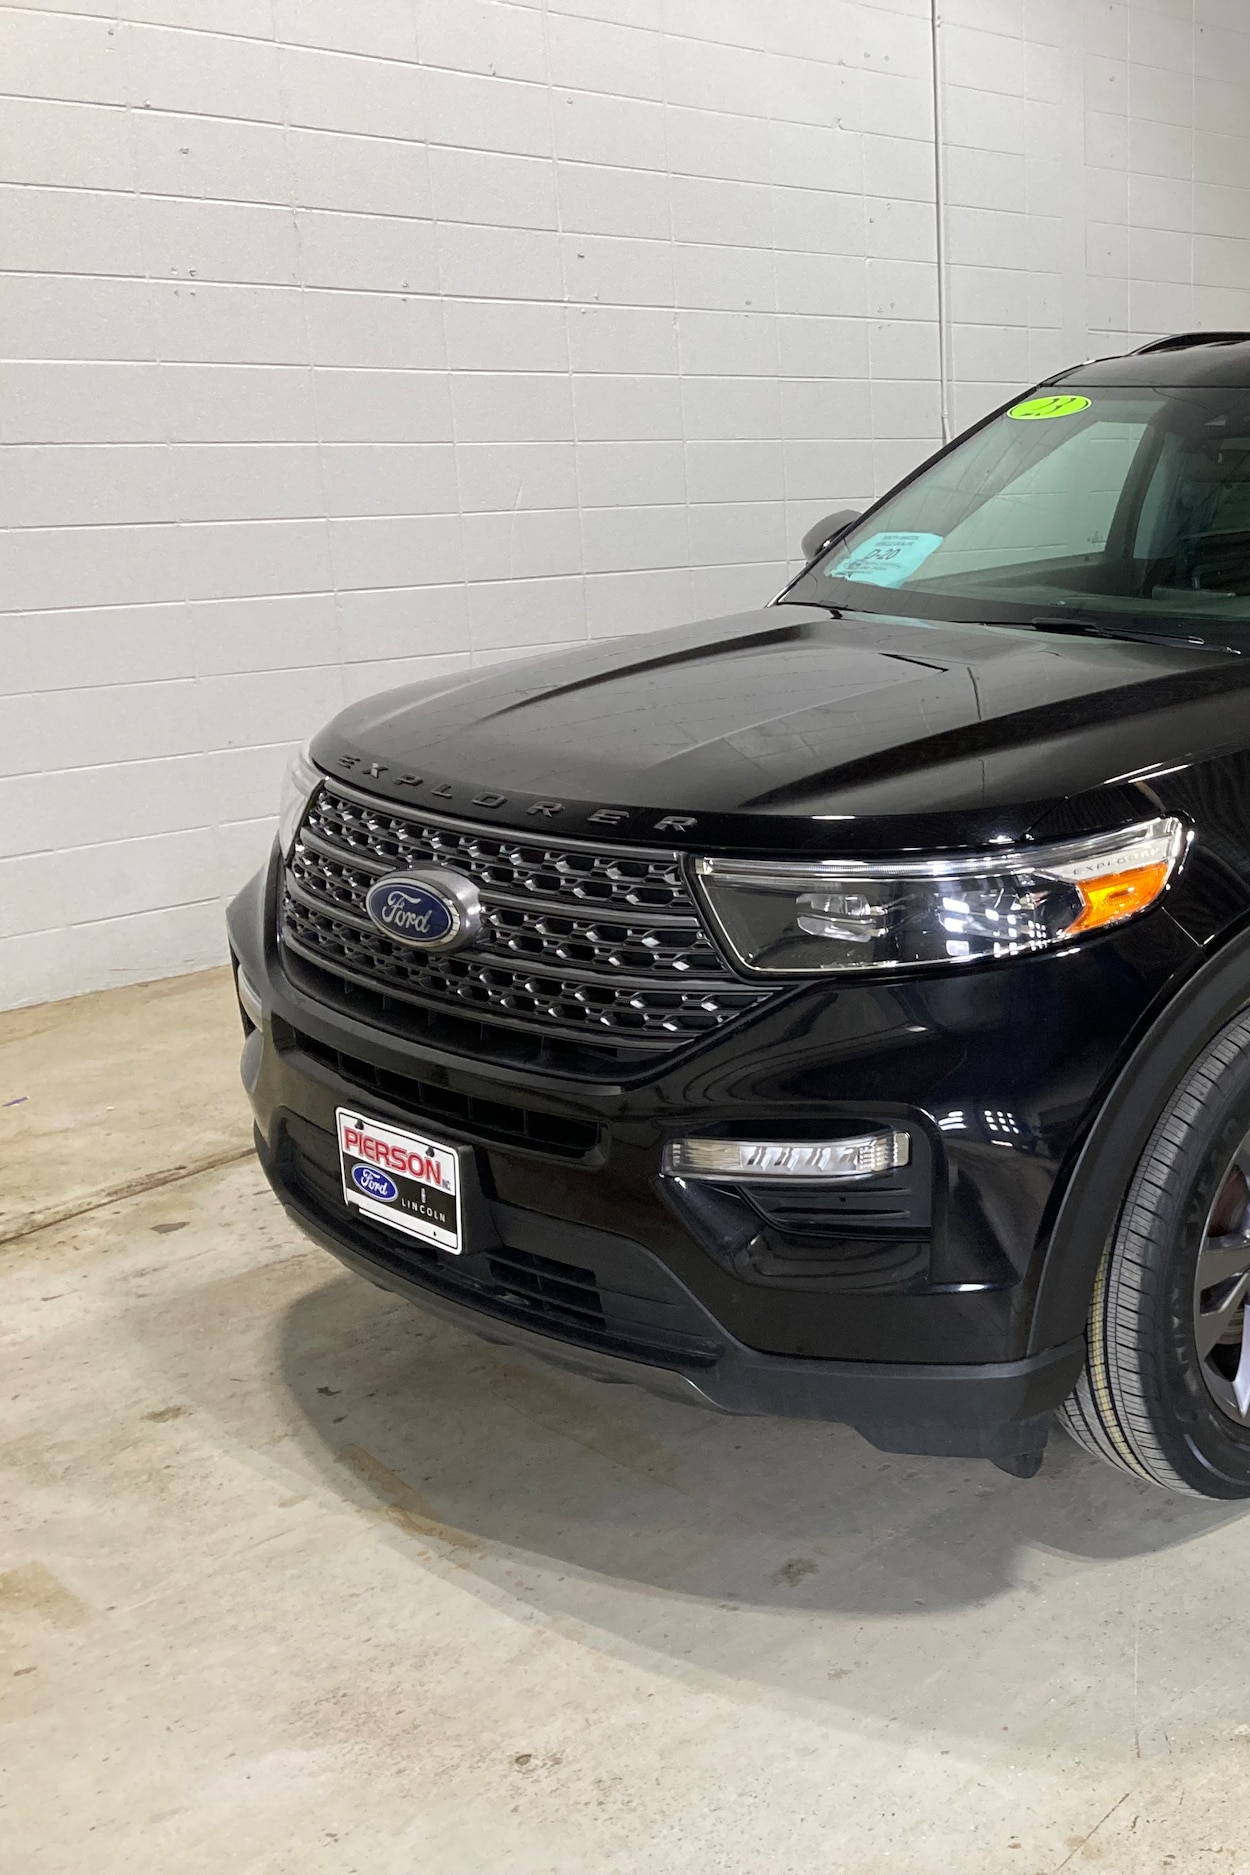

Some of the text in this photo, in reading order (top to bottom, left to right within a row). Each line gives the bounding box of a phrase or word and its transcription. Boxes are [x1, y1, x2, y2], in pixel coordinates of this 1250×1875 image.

[863, 548, 902, 561] D-20
[336, 753, 699, 833] EXPLORER
[381, 890, 433, 934] Ford
[343, 1126, 443, 1188] PIERSON
[360, 1168, 389, 1196] Ford
[401, 1197, 446, 1223] LINCOLN
